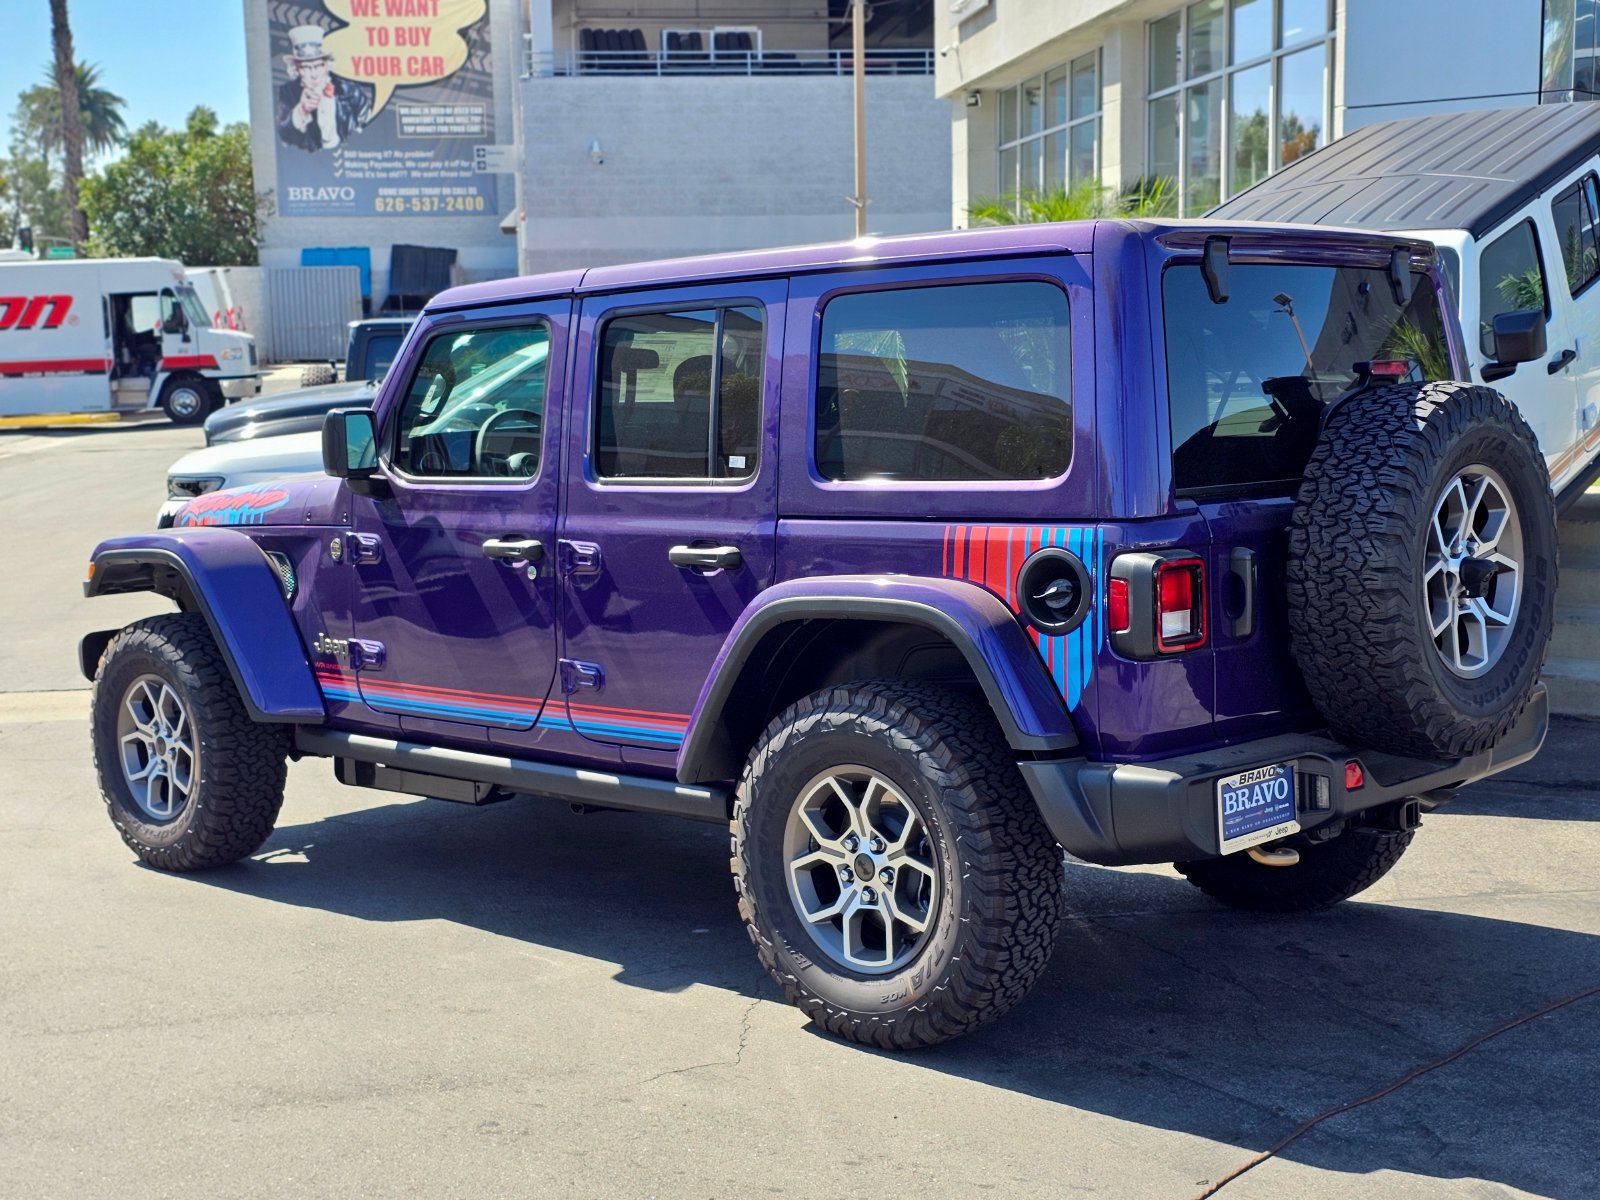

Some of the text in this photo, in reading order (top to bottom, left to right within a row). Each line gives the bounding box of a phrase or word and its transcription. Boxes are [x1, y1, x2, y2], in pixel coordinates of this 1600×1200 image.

[350, 0, 440, 17] WE WANT
[365, 27, 432, 47] TO BUY
[351, 56, 445, 77] YOUR CAR
[287, 186, 355, 200] BRAVO
[374, 196, 484, 212] 626-537-2400
[314, 632, 348, 659] Jeep
[1238, 766, 1276, 786] BRAVO
[1223, 778, 1288, 816] BRAVO
[1274, 826, 1288, 836] Jeep
